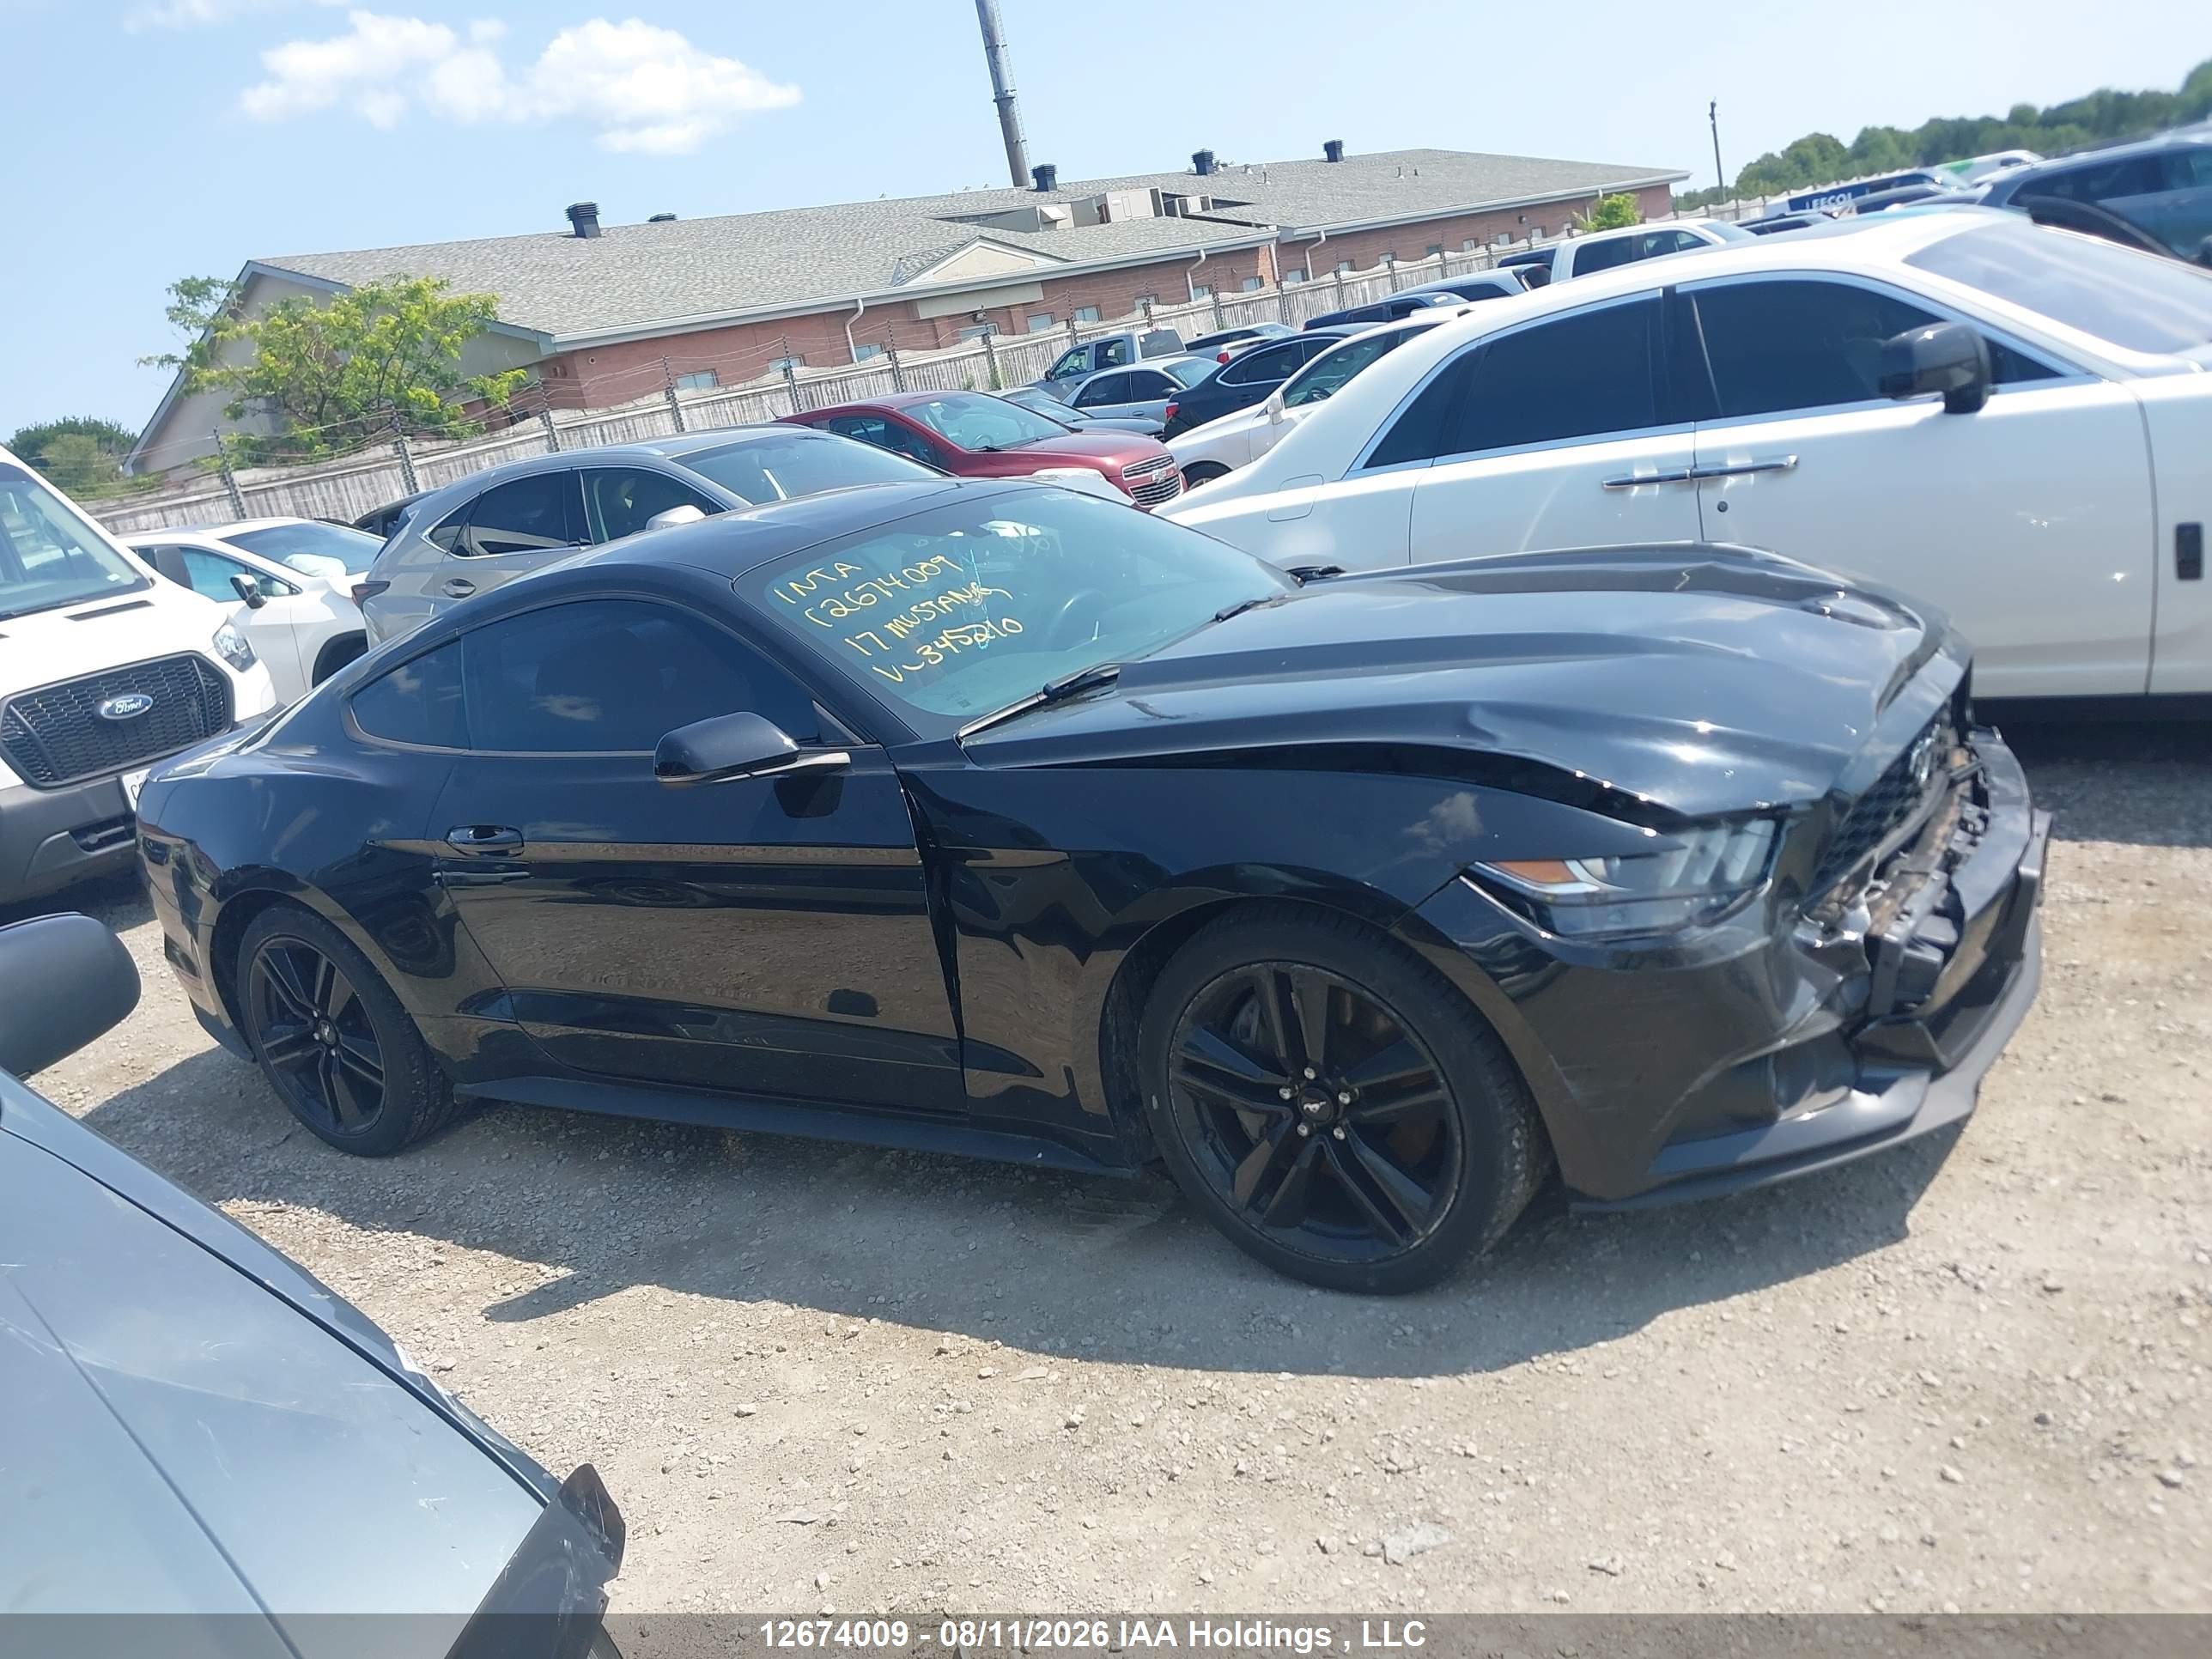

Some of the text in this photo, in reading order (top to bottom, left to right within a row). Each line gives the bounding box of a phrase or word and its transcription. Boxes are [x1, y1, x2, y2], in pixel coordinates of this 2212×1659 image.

[804, 555, 963, 628] 12674009
[844, 581, 1014, 656] 17 MUSTANG
[115, 698, 144, 714] Ford
